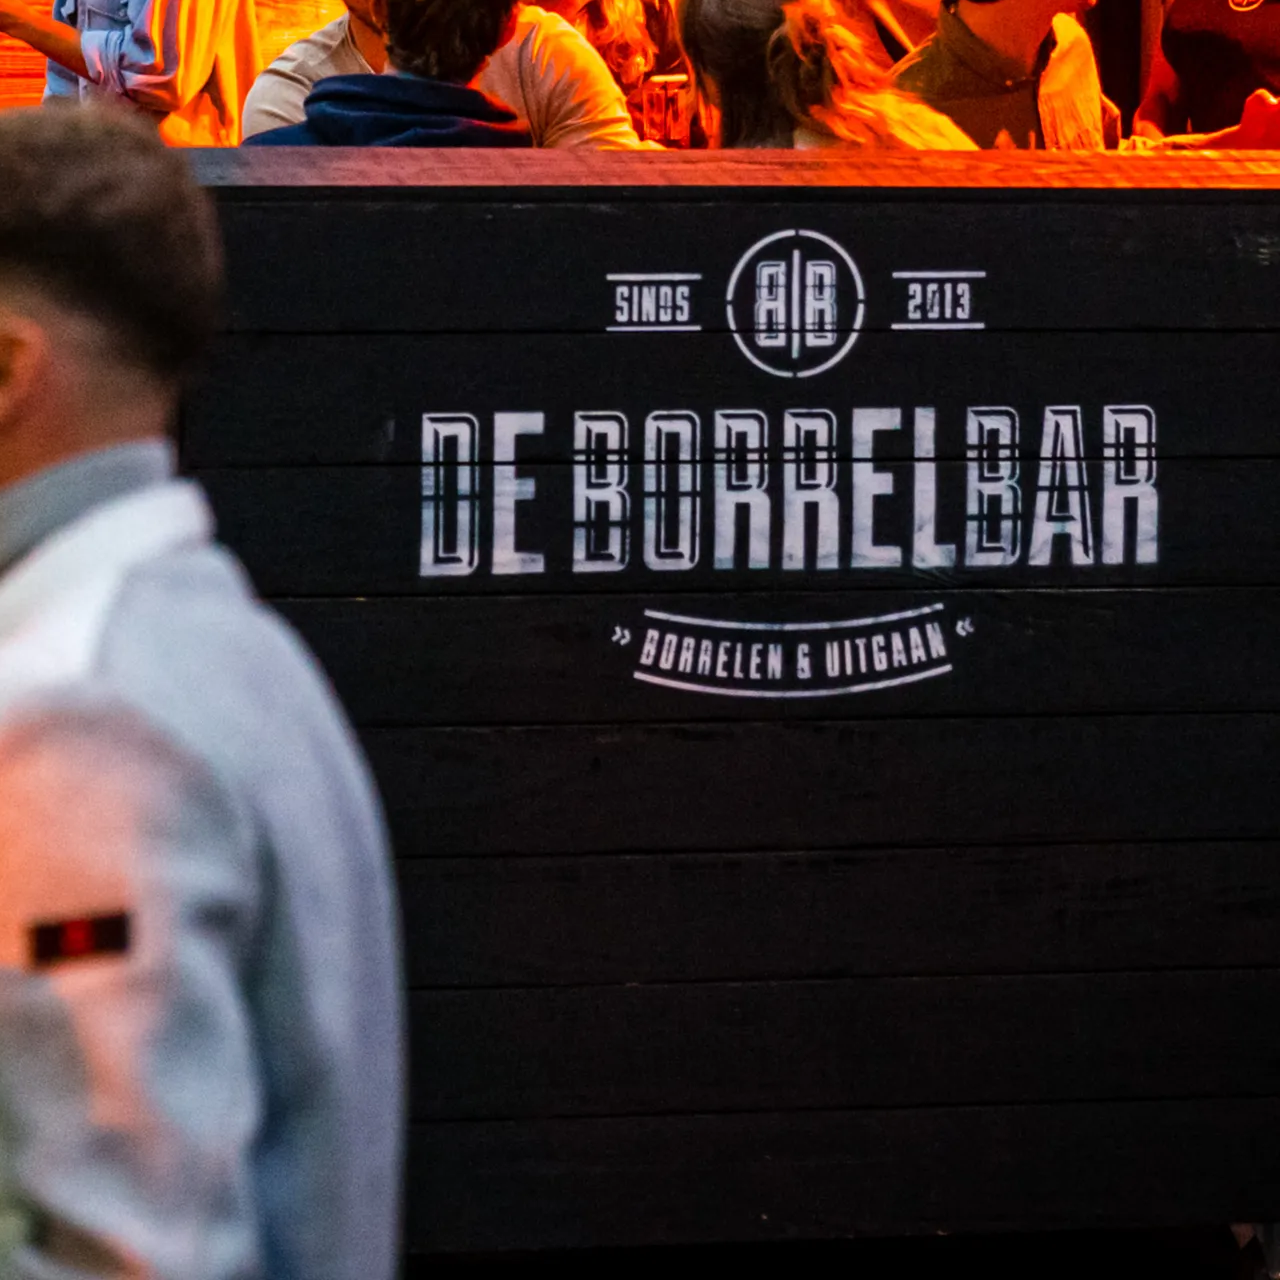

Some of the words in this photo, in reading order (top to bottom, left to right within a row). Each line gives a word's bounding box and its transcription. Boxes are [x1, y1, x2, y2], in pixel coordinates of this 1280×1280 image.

[615, 285, 690, 323] SINDS
[907, 282, 971, 320] 2013
[418, 411, 546, 577] DE
[571, 405, 1162, 573] BORRELBAR
[640, 627, 783, 681] BORRELEN
[825, 620, 948, 679] UITGAAN
